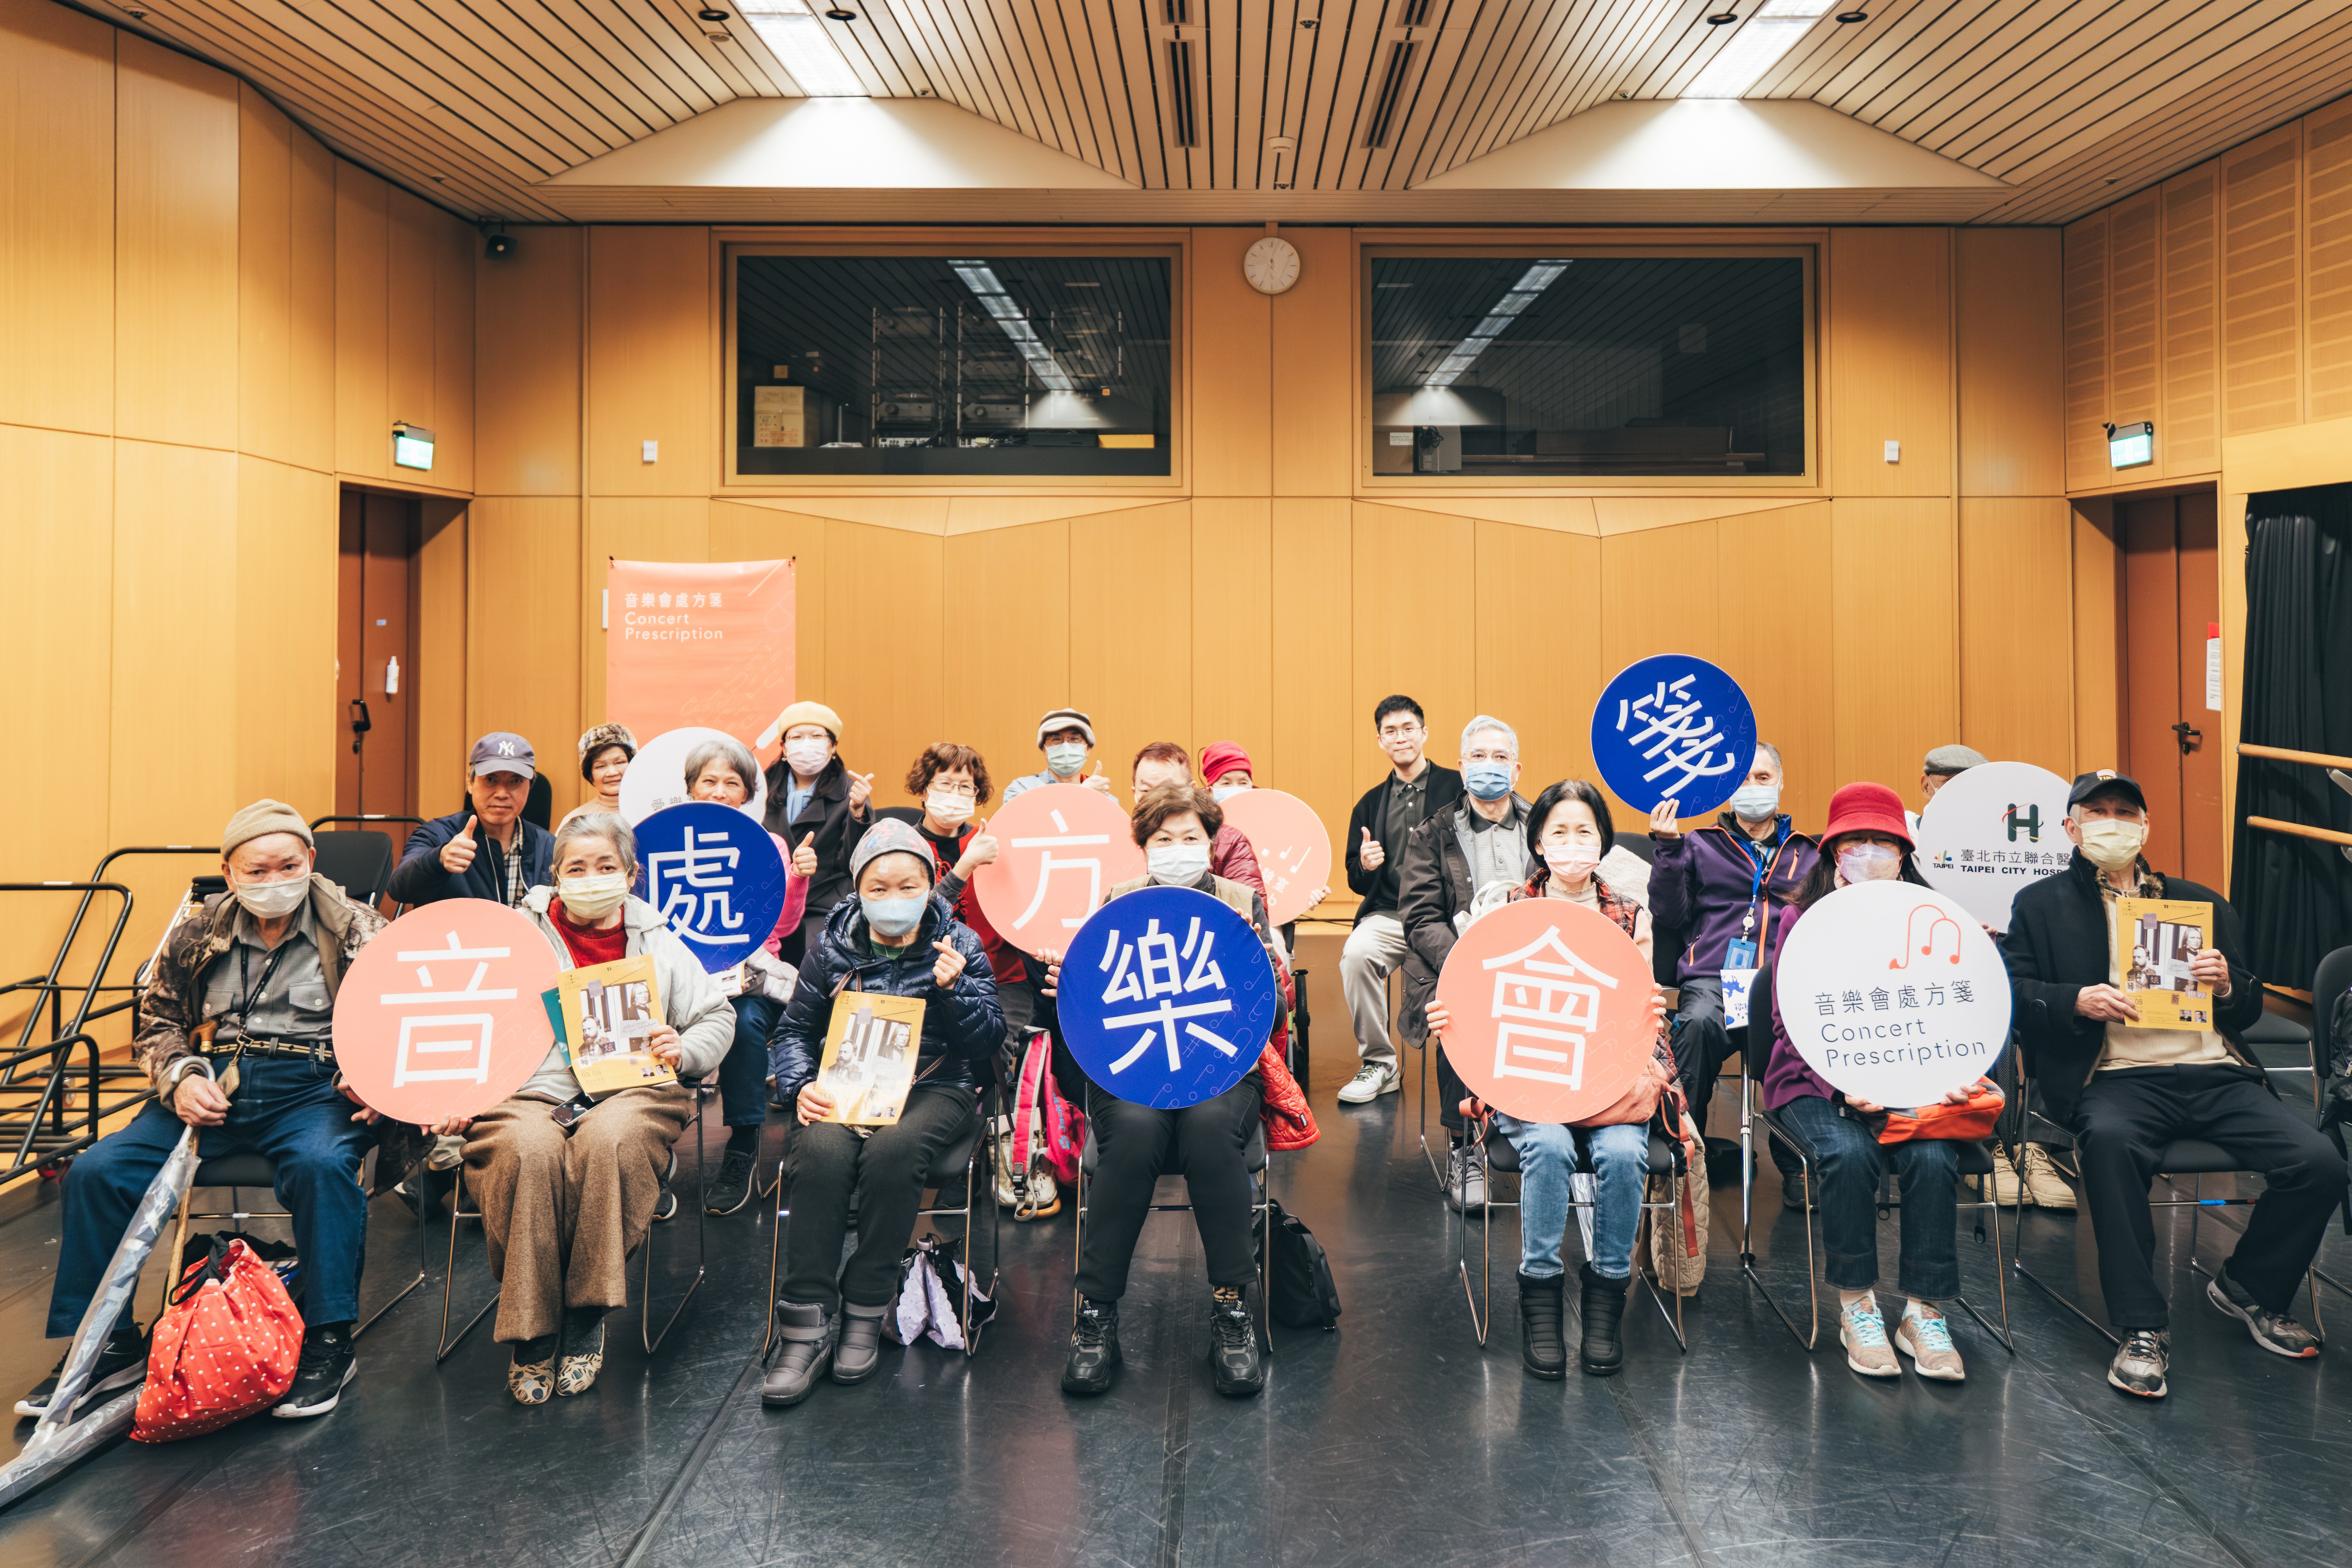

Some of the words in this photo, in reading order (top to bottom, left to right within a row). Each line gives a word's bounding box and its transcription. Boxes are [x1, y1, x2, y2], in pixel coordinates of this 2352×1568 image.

[625, 592, 722, 608] 音樂會處方箋
[625, 611, 689, 624] Concert
[625, 627, 723, 642] Prescription
[498, 740, 514, 755] NY
[1616, 674, 1735, 798] 箋
[1011, 808, 1109, 930] 方
[1260, 867, 1289, 893] 驗室
[1961, 865, 1994, 873] TAIPEI
[648, 826, 749, 944] 處
[381, 930, 517, 1088] 音
[1099, 917, 1238, 1074] 樂
[1482, 925, 1619, 1090] 會
[1815, 980, 1974, 1016] 音樂會處方箋
[1821, 1019, 1926, 1042] Concert
[1826, 1040, 1986, 1067] Prescription
[1056, 1104, 1066, 1134] Jack
